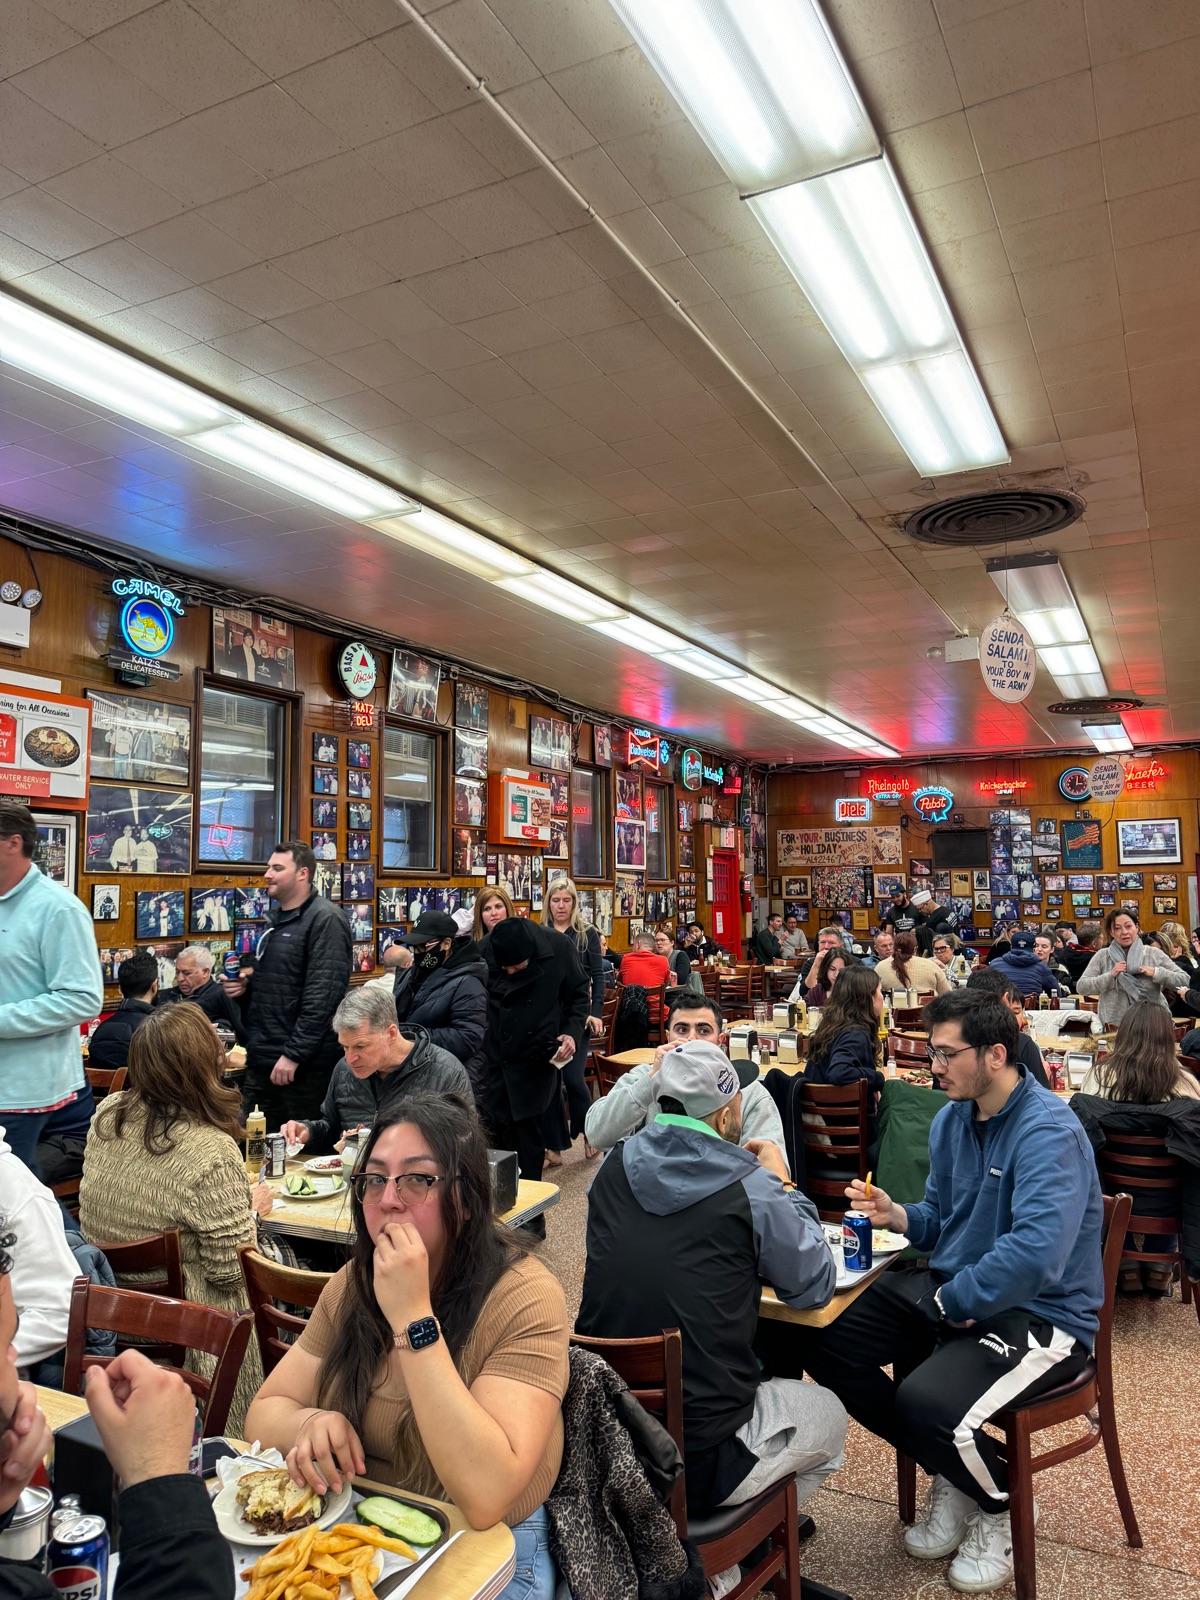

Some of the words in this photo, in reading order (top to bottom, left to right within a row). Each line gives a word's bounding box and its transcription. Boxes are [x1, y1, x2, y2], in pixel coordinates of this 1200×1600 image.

[112, 579, 185, 615] CAMEL
[987, 644, 1029, 661] SALAMI
[131, 655, 160, 669] KATZ'S
[344, 652, 354, 672] BASS
[1002, 660, 1014, 668] TO
[121, 661, 170, 679] DELICATESSEN
[986, 665, 1004, 677] YOUR
[1006, 668, 1021, 678] BOY
[1023, 671, 1031, 681] IN
[992, 679, 1006, 689] THE
[1007, 680, 1028, 691] ARMY
[17, 702, 27, 711] for
[28, 703, 40, 713] All
[41, 706, 70, 717] Occasions
[356, 715, 373, 726] DELI
[630, 742, 657, 758] Budweiser
[1123, 760, 1165, 781] chaefer
[15, 781, 31, 790] ONLY
[23, 775, 50, 785] SERVICE
[867, 779, 910, 793] Rheingold
[920, 797, 946, 810] Pabst
[781, 833, 796, 844] FOR
[799, 832, 819, 843] YOUR
[800, 843, 837, 855] HOLIDAY
[844, 1238, 858, 1247] PSI
[979, 1338, 1004, 1354] PUMA
